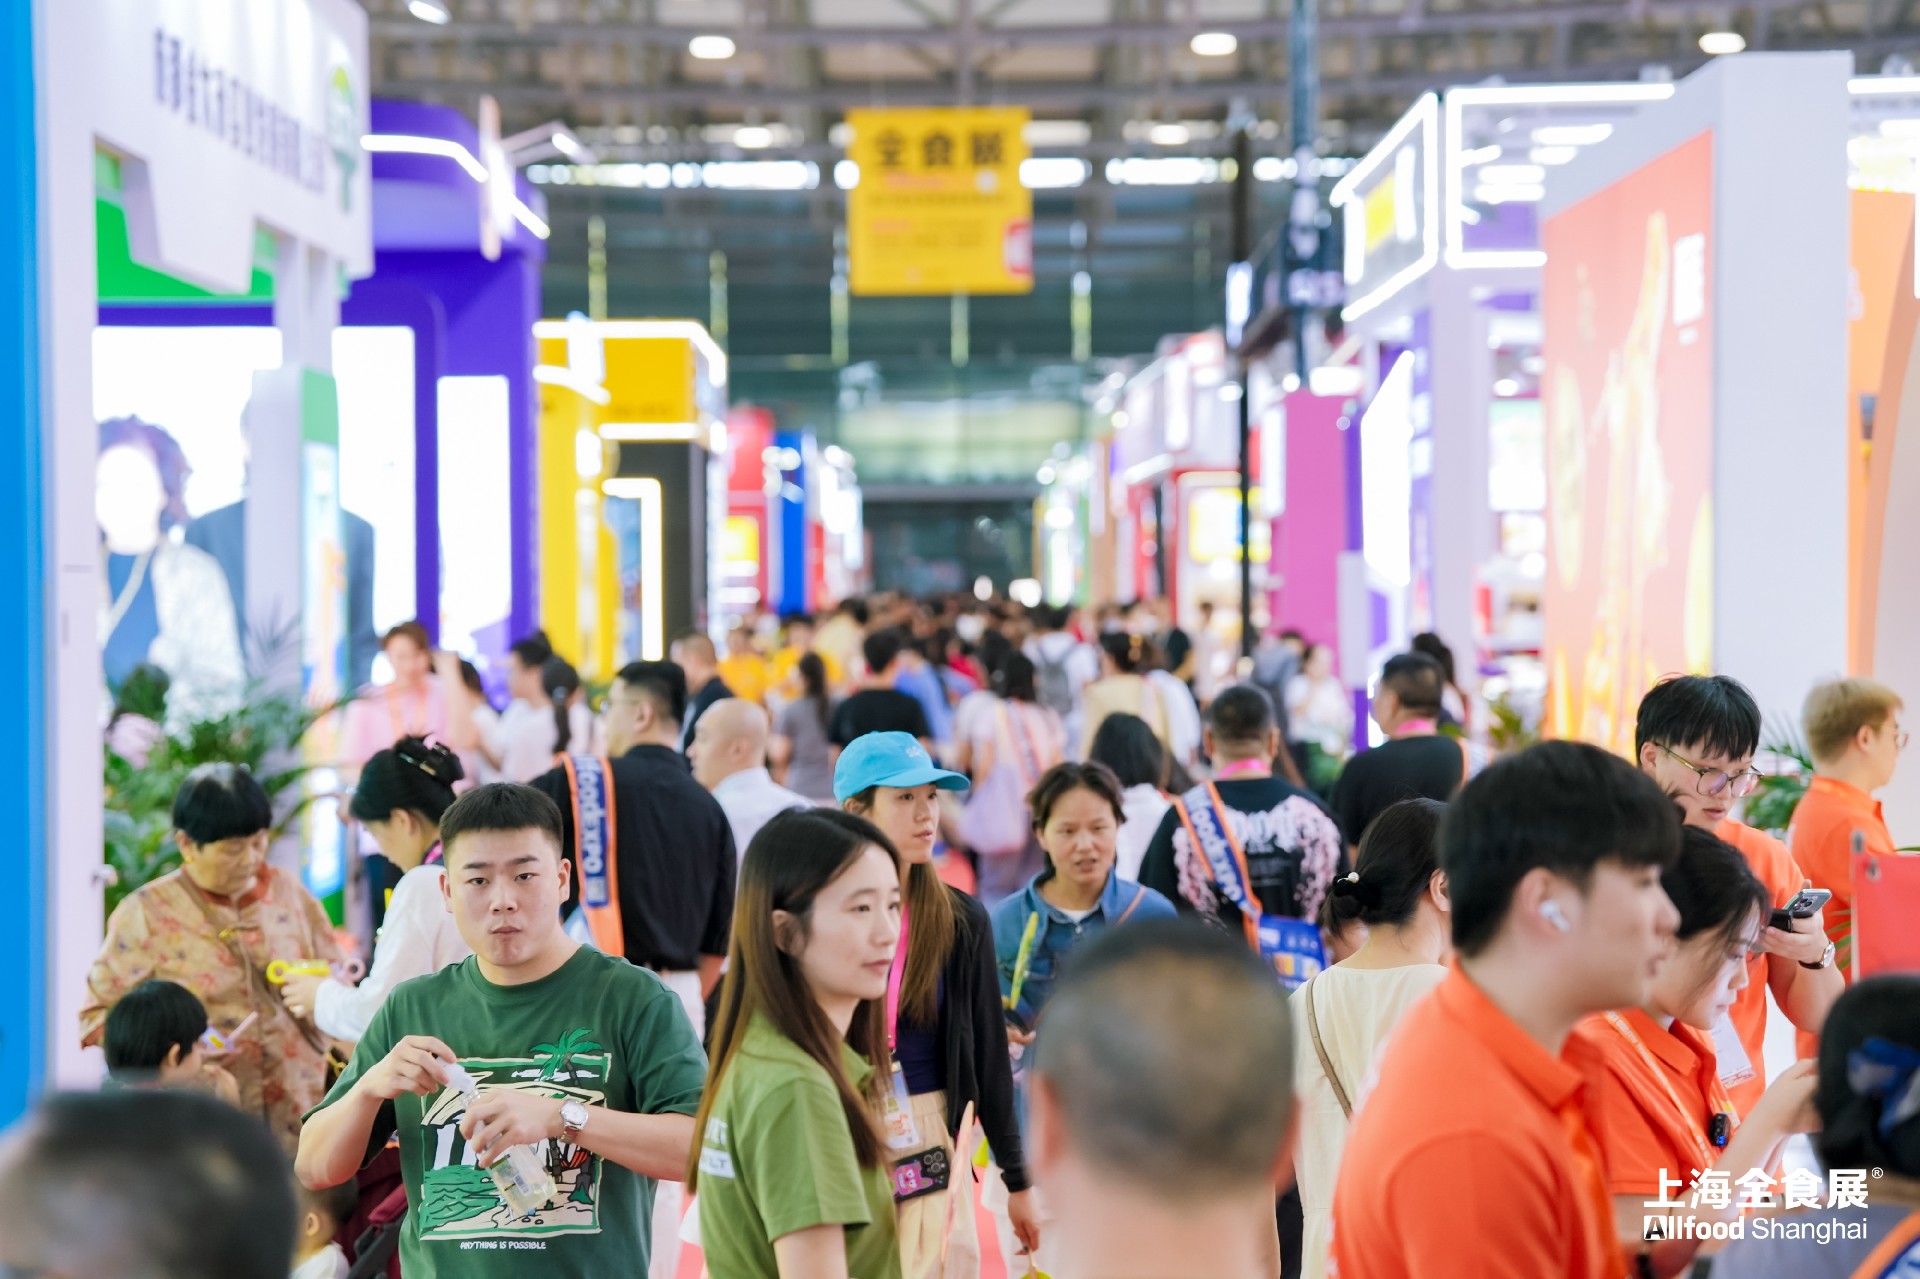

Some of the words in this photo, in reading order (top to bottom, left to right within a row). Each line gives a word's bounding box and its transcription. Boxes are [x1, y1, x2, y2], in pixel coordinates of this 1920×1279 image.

[460, 1241, 498, 1250] ANYTHING
[499, 1241, 507, 1249] IS
[508, 1241, 547, 1250] POSSIBLE
